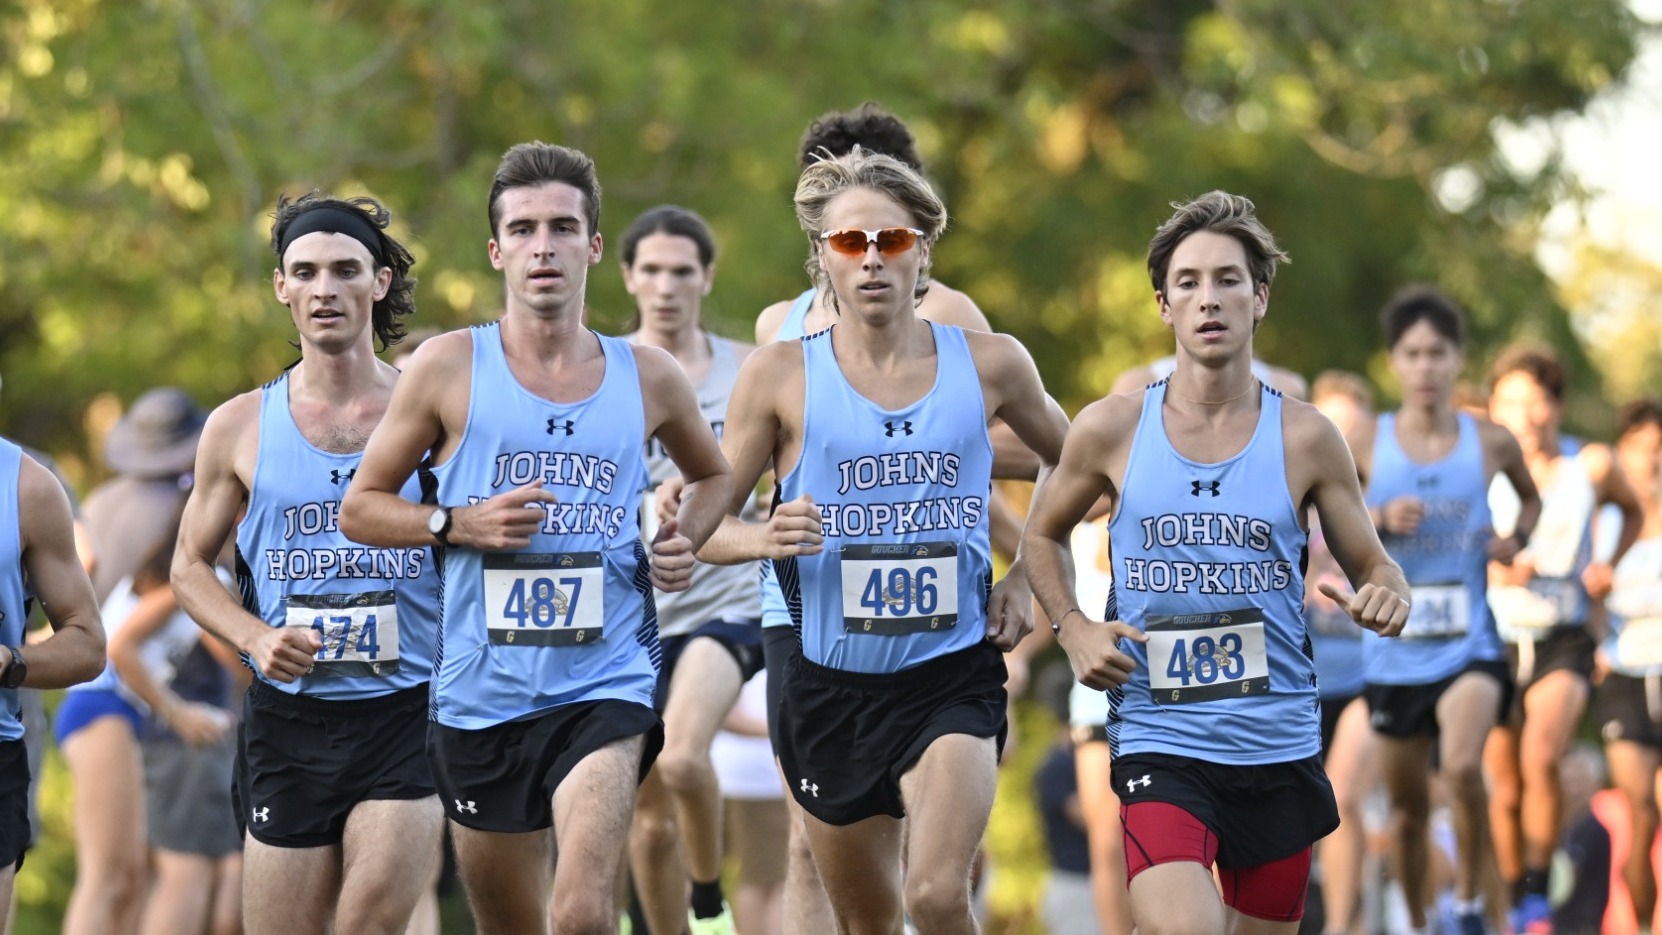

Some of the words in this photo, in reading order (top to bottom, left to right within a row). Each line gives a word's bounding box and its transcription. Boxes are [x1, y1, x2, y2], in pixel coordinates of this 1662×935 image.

[491, 451, 618, 495] JOHNS
[838, 451, 960, 495] JOHNS
[284, 500, 341, 541] JOH
[468, 496, 626, 539] KINS
[816, 496, 982, 537] HOPKINS
[1141, 512, 1271, 551] JOHNS
[266, 547, 425, 581] HOPKINS
[871, 545, 910, 554] GOUCHER
[861, 566, 937, 617] 496
[1124, 559, 1291, 594] HOPKINS
[503, 577, 582, 628] 487
[1173, 614, 1212, 624] GOUCHER
[310, 614, 380, 660] 474
[1166, 633, 1245, 686] 483
